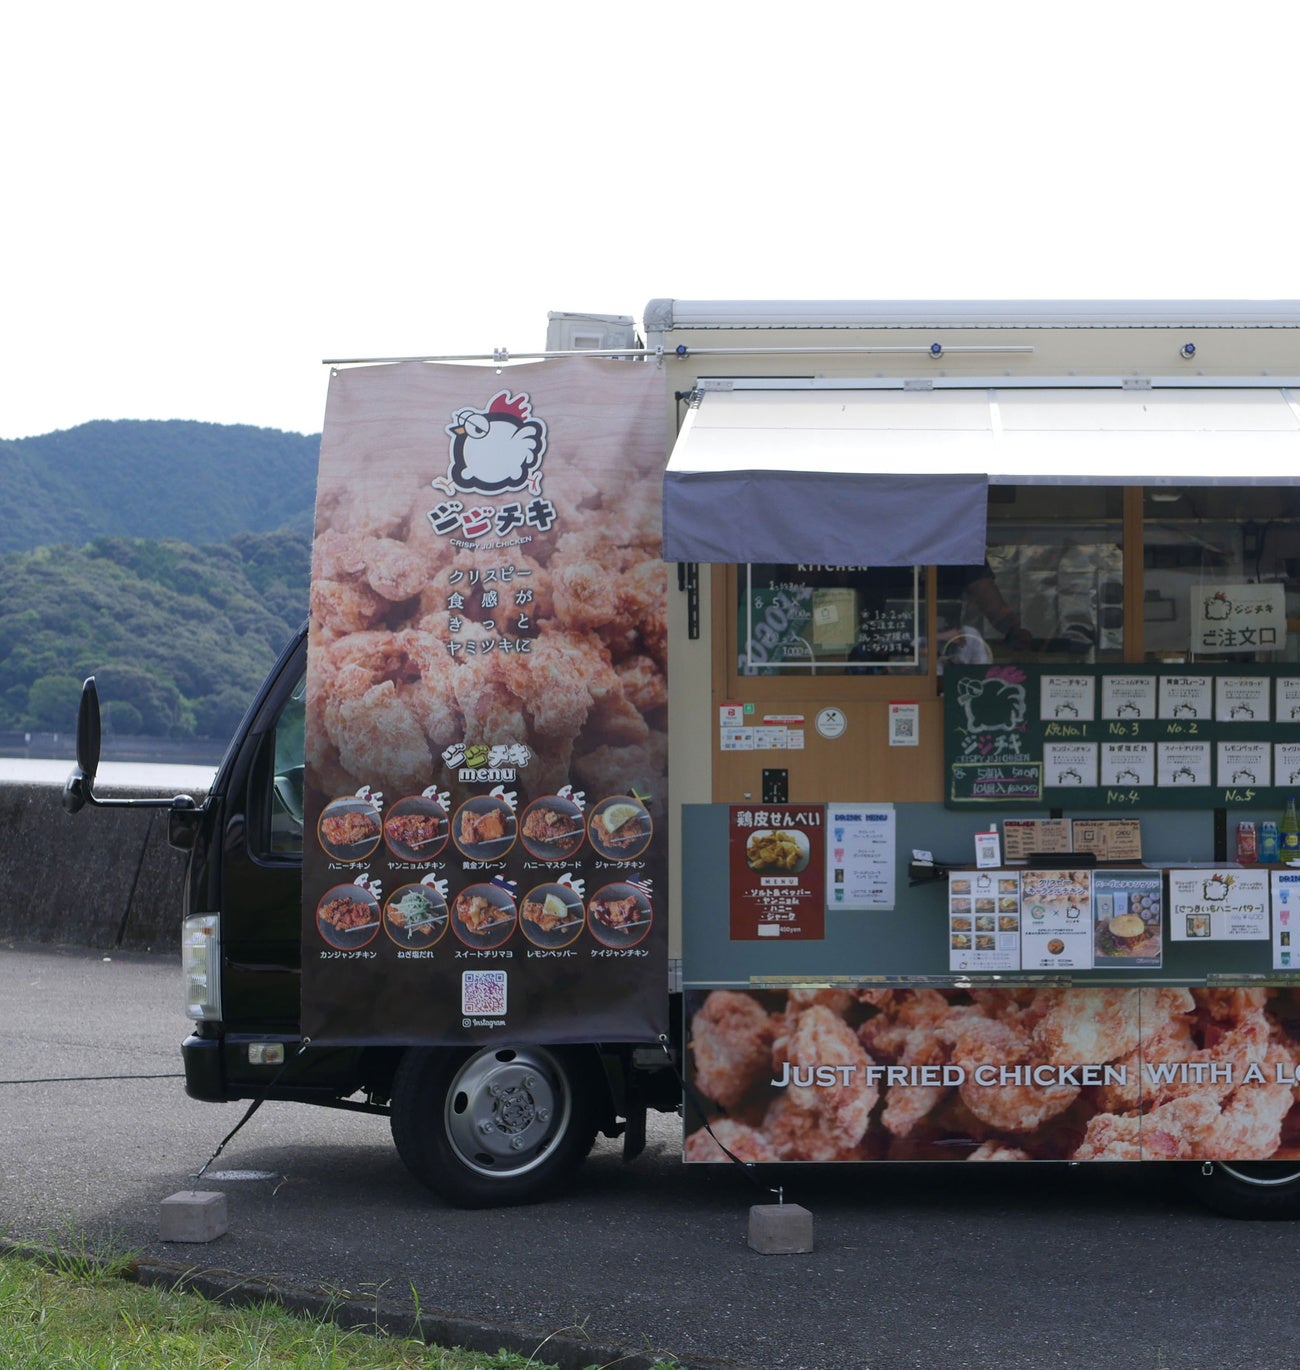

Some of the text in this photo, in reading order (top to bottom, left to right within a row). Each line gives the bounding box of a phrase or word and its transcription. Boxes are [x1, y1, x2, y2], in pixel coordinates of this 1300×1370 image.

[429, 499, 556, 537] ジジチキ
[450, 538, 480, 549] CRISPY
[496, 535, 532, 548] CHICKEN
[449, 567, 532, 583] クリスピー
[1202, 627, 1278, 647] ご注文口
[447, 638, 531, 655] ヤミツキに
[441, 743, 531, 769] ジジチキ
[459, 767, 516, 782] menu
[737, 811, 820, 828] 鶏皮せんべい
[328, 862, 371, 870] ハニーチキン
[388, 861, 446, 870] ヤンニョムチキン
[462, 861, 507, 870] 黄金プレーン
[524, 861, 581, 869] ハニーマスタード
[595, 860, 646, 869] ジャークチキン
[320, 951, 377, 959] カンジャンチキン
[397, 951, 434, 959] ねぎ塩だれ
[454, 950, 513, 959] スイートチリマヨ
[527, 949, 577, 958] レモンペッパー
[590, 949, 649, 958] ケイジャンチキン
[473, 1018, 506, 1028] Instagram
[771, 1061, 856, 1088] JUST
[866, 1064, 965, 1087] FRIED
[974, 1063, 1127, 1087] CHICKEN
[1146, 1062, 1233, 1085] WITH
[1244, 1063, 1267, 1085] A
